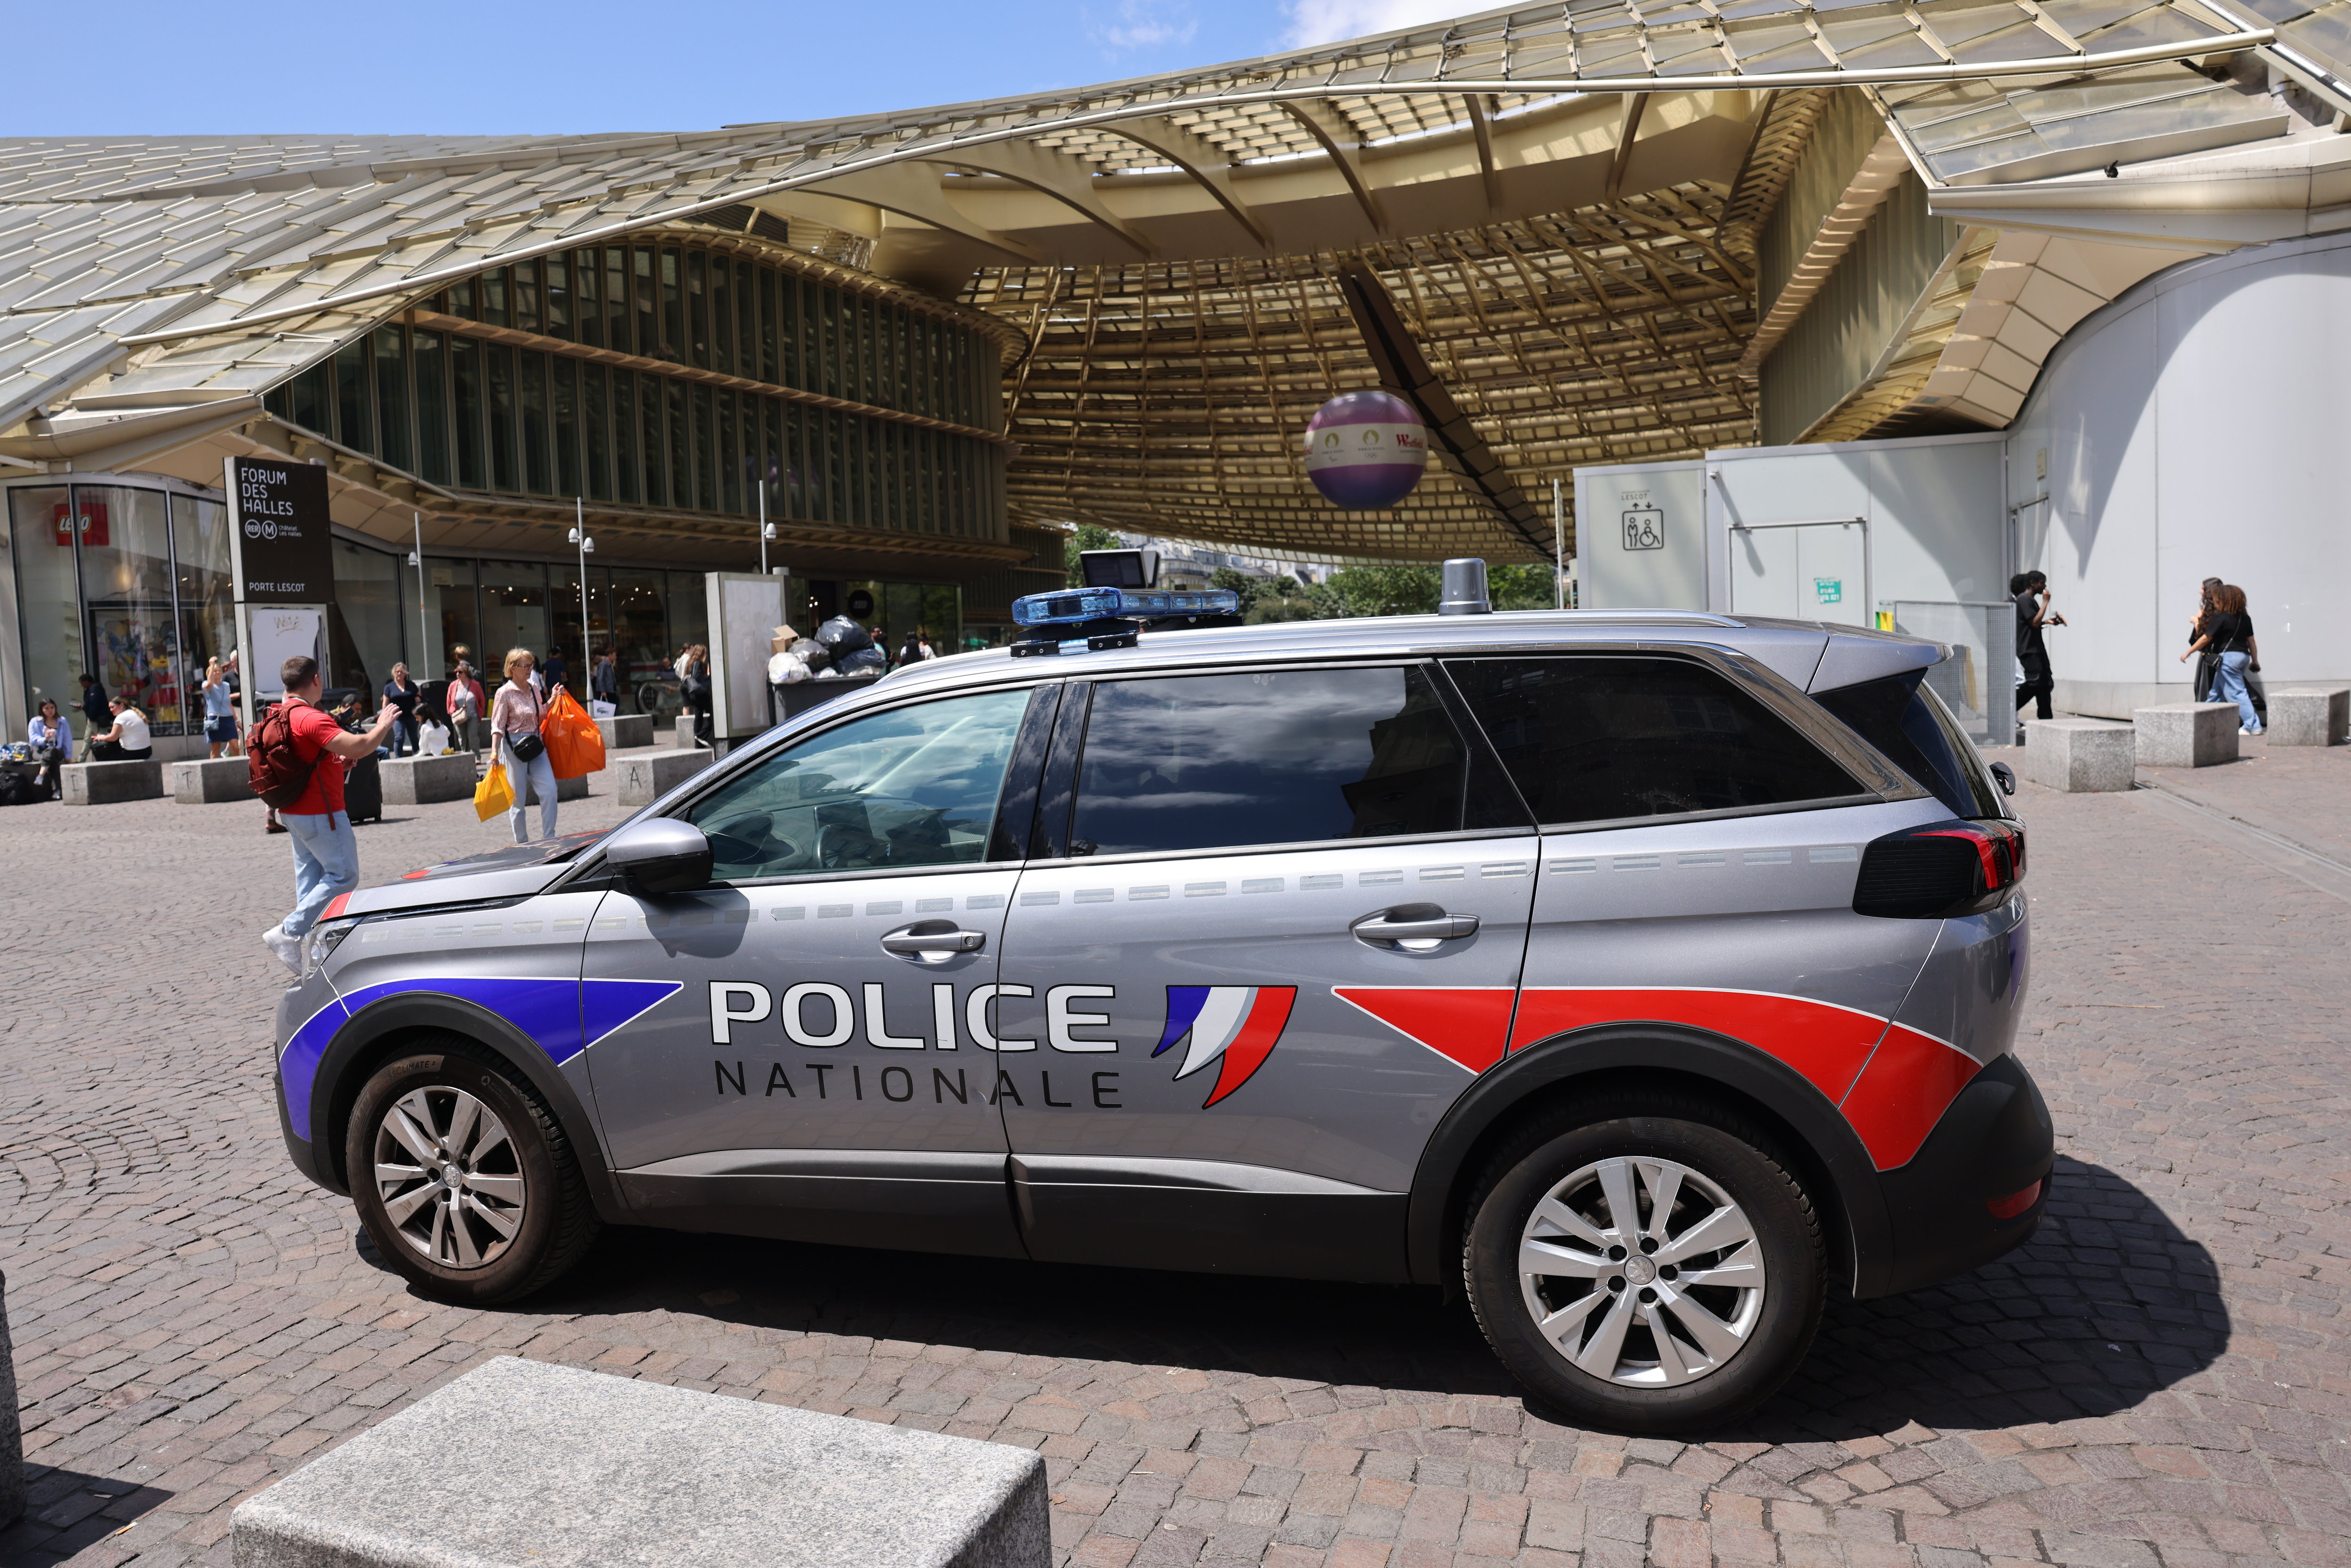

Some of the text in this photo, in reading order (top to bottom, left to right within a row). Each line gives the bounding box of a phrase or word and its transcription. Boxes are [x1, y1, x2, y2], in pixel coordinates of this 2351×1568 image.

[241, 467, 286, 485] FORUM
[242, 483, 268, 498] DES
[244, 498, 293, 515] HALLES
[58, 515, 90, 532] LEO
[247, 524, 274, 535] RER M
[249, 582, 305, 592] PORTE LESCOT
[708, 980, 1119, 1053] POLICE
[715, 1060, 1122, 1108] NATIONALE
